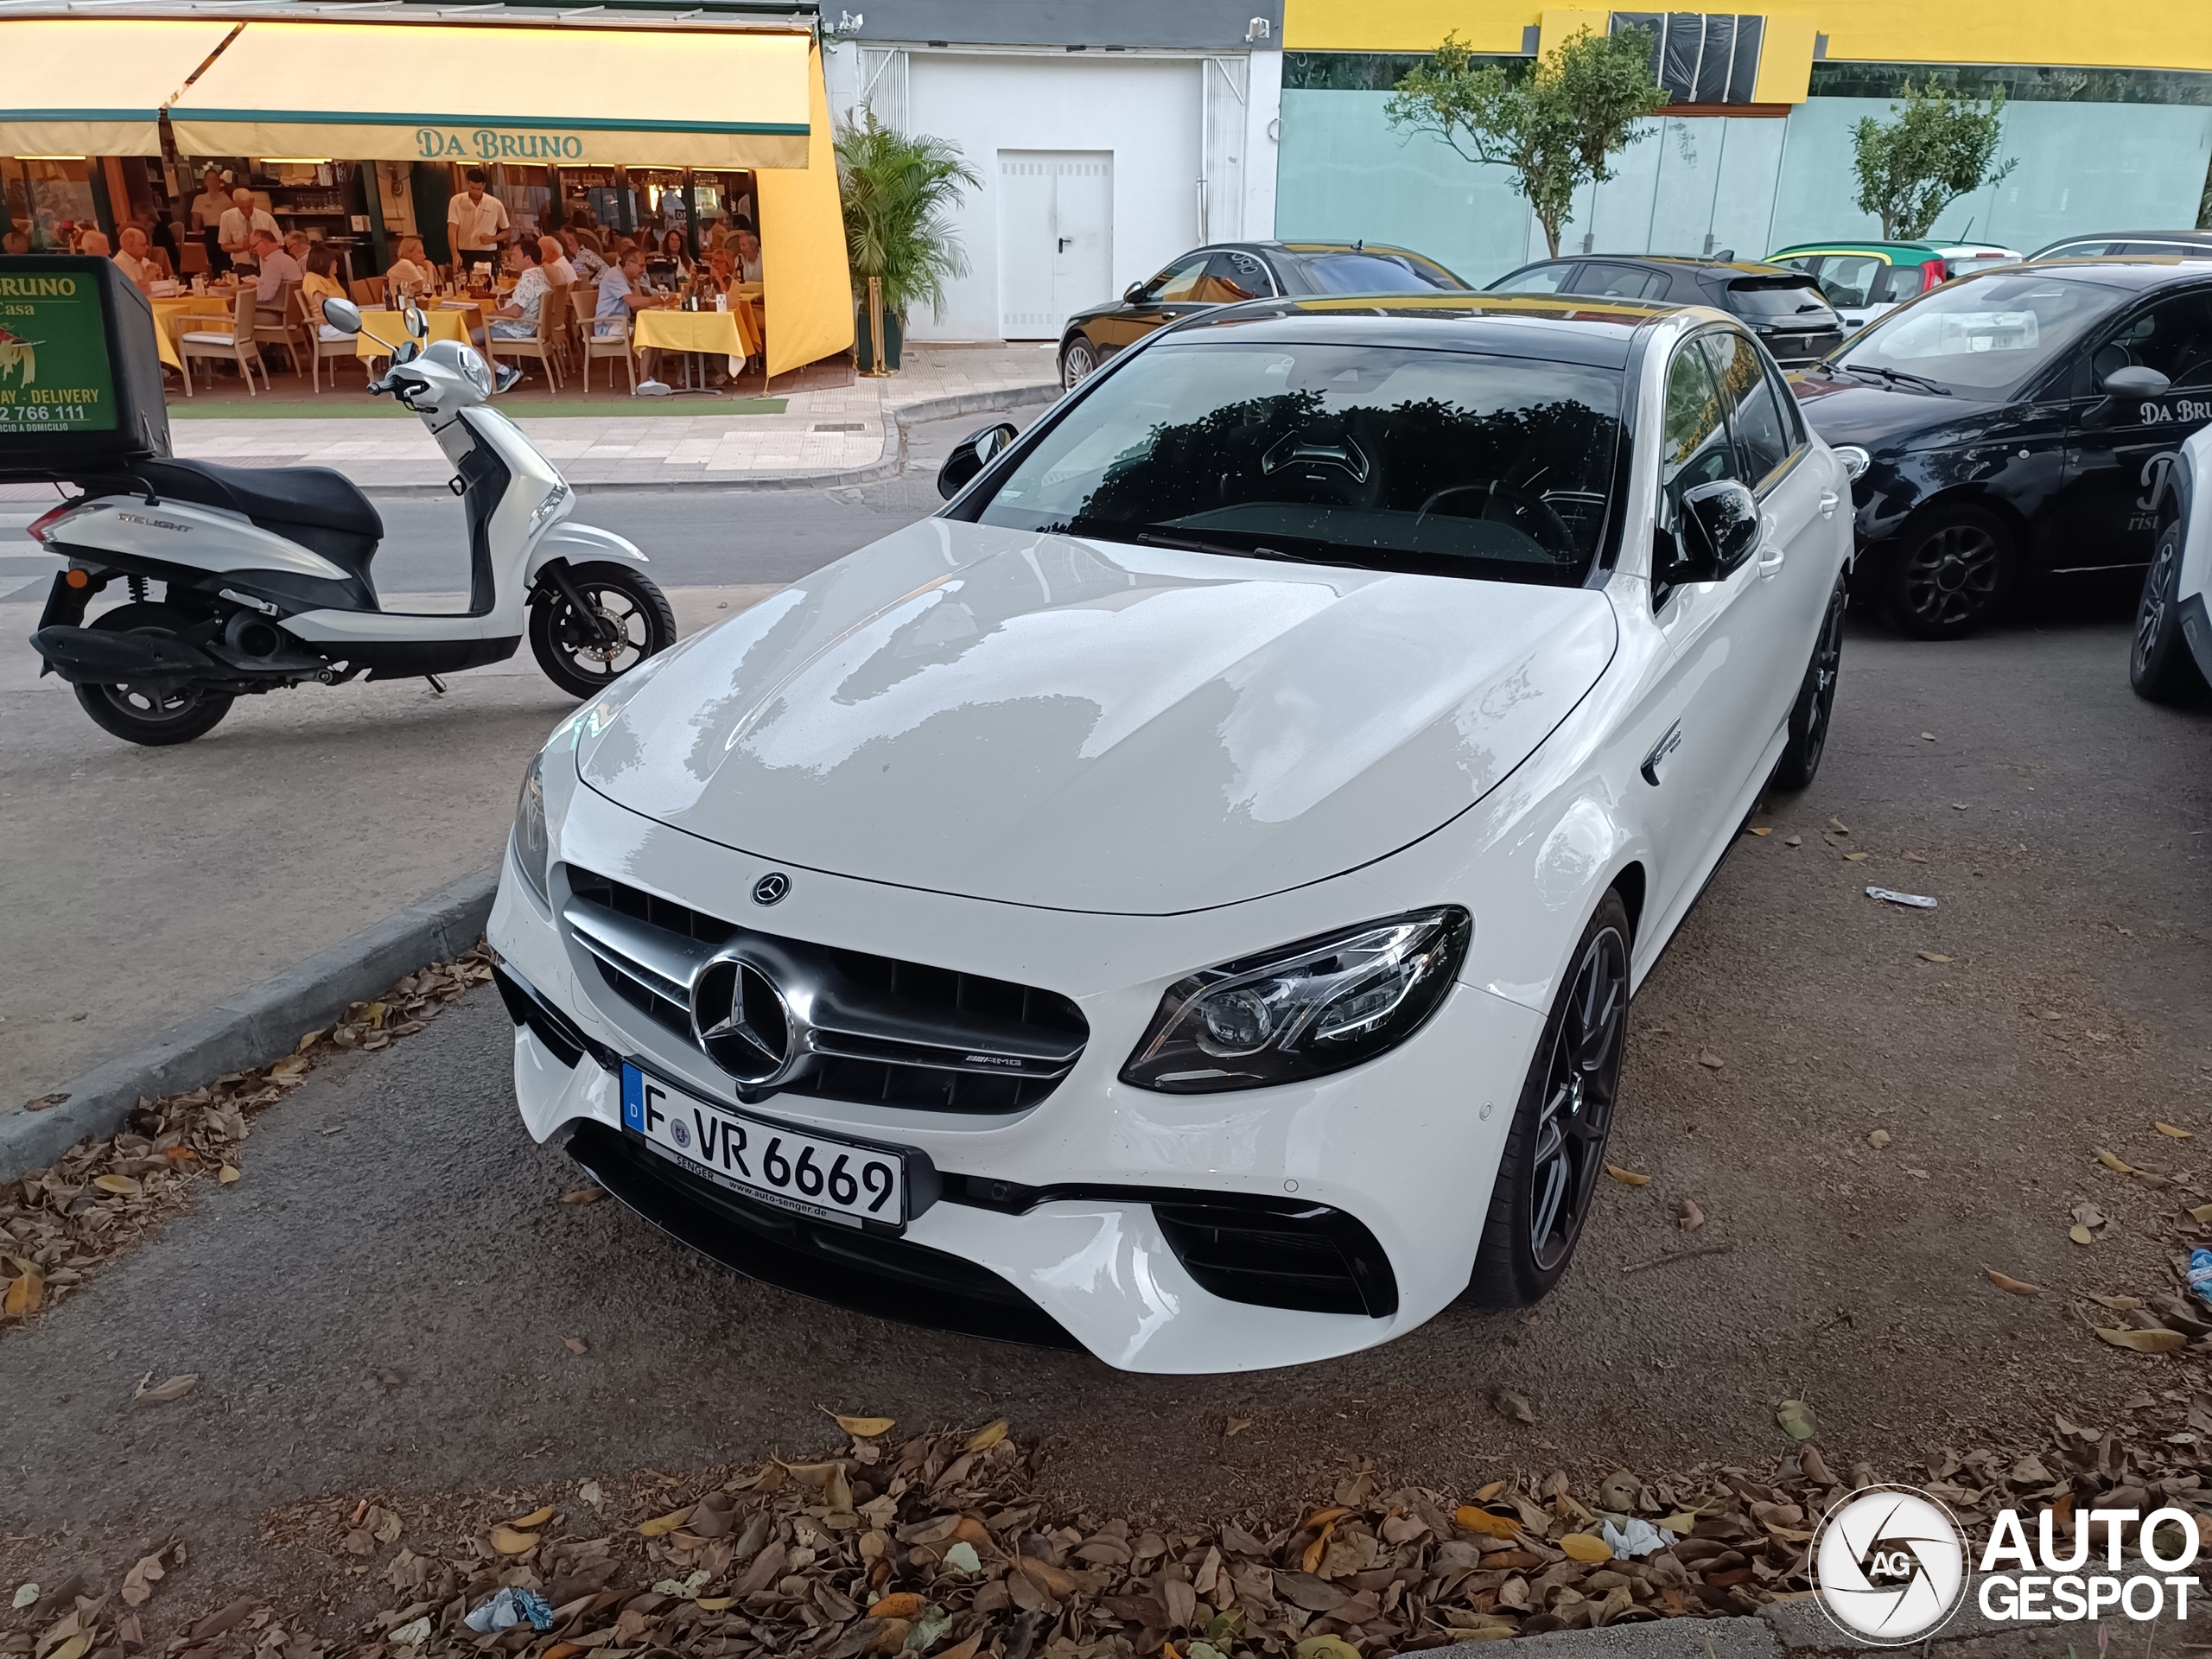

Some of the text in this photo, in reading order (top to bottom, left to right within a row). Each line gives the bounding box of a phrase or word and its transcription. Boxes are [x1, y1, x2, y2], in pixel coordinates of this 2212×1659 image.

[416, 128, 583, 160] DA BRUNO
[0, 277, 76, 296] RUNO
[0, 299, 35, 315] asa
[31, 389, 99, 404] DELIVERY
[15, 406, 49, 421] 766
[55, 405, 84, 420] 111
[2140, 402, 2173, 425] DA
[19, 423, 25, 432] A
[26, 423, 69, 433] DOMICILIO
[984, 1056, 1022, 1067] AMG
[630, 1103, 639, 1118] D
[645, 1084, 894, 1213] F VR 6669
[676, 1156, 828, 1217] SENGER www.auto-senger.de
